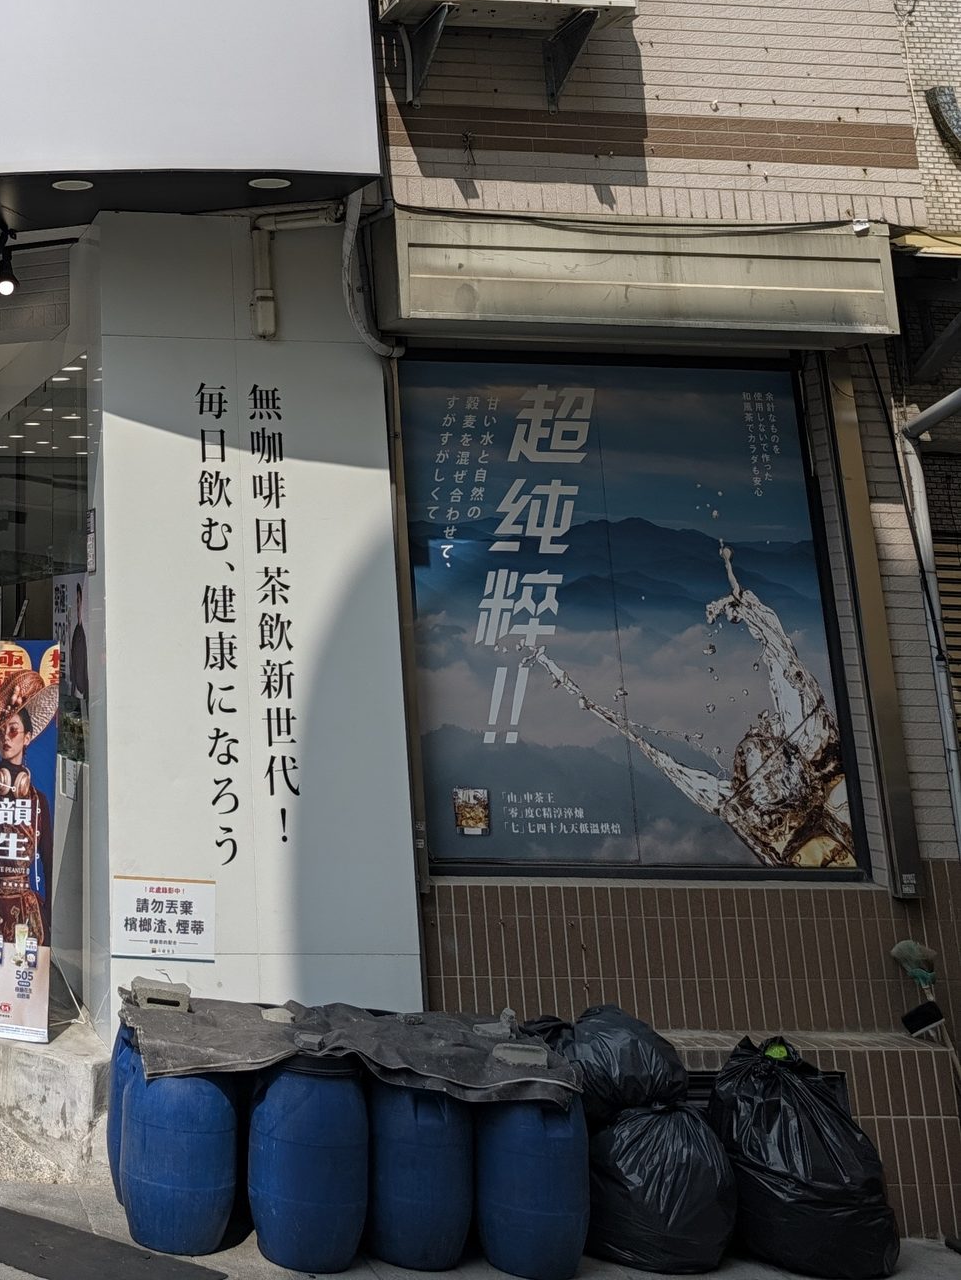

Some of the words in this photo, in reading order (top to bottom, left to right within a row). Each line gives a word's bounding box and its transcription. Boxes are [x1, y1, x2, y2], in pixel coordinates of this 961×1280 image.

[742, 391, 764, 497] 和風茶でカラダも安心
[765, 391, 780, 454] 余計なものを
[427, 395, 460, 520] すがすがしくて
[467, 396, 500, 519] 甘い水と自然の
[194, 382, 240, 867] 毎日飲む、健康になろう
[5, 866, 26, 874] PEANUT
[124, 916, 205, 936] 檳榔渣、煙蒂
[136, 898, 194, 916] 請勿丟棄
[15, 970, 34, 981] 505
